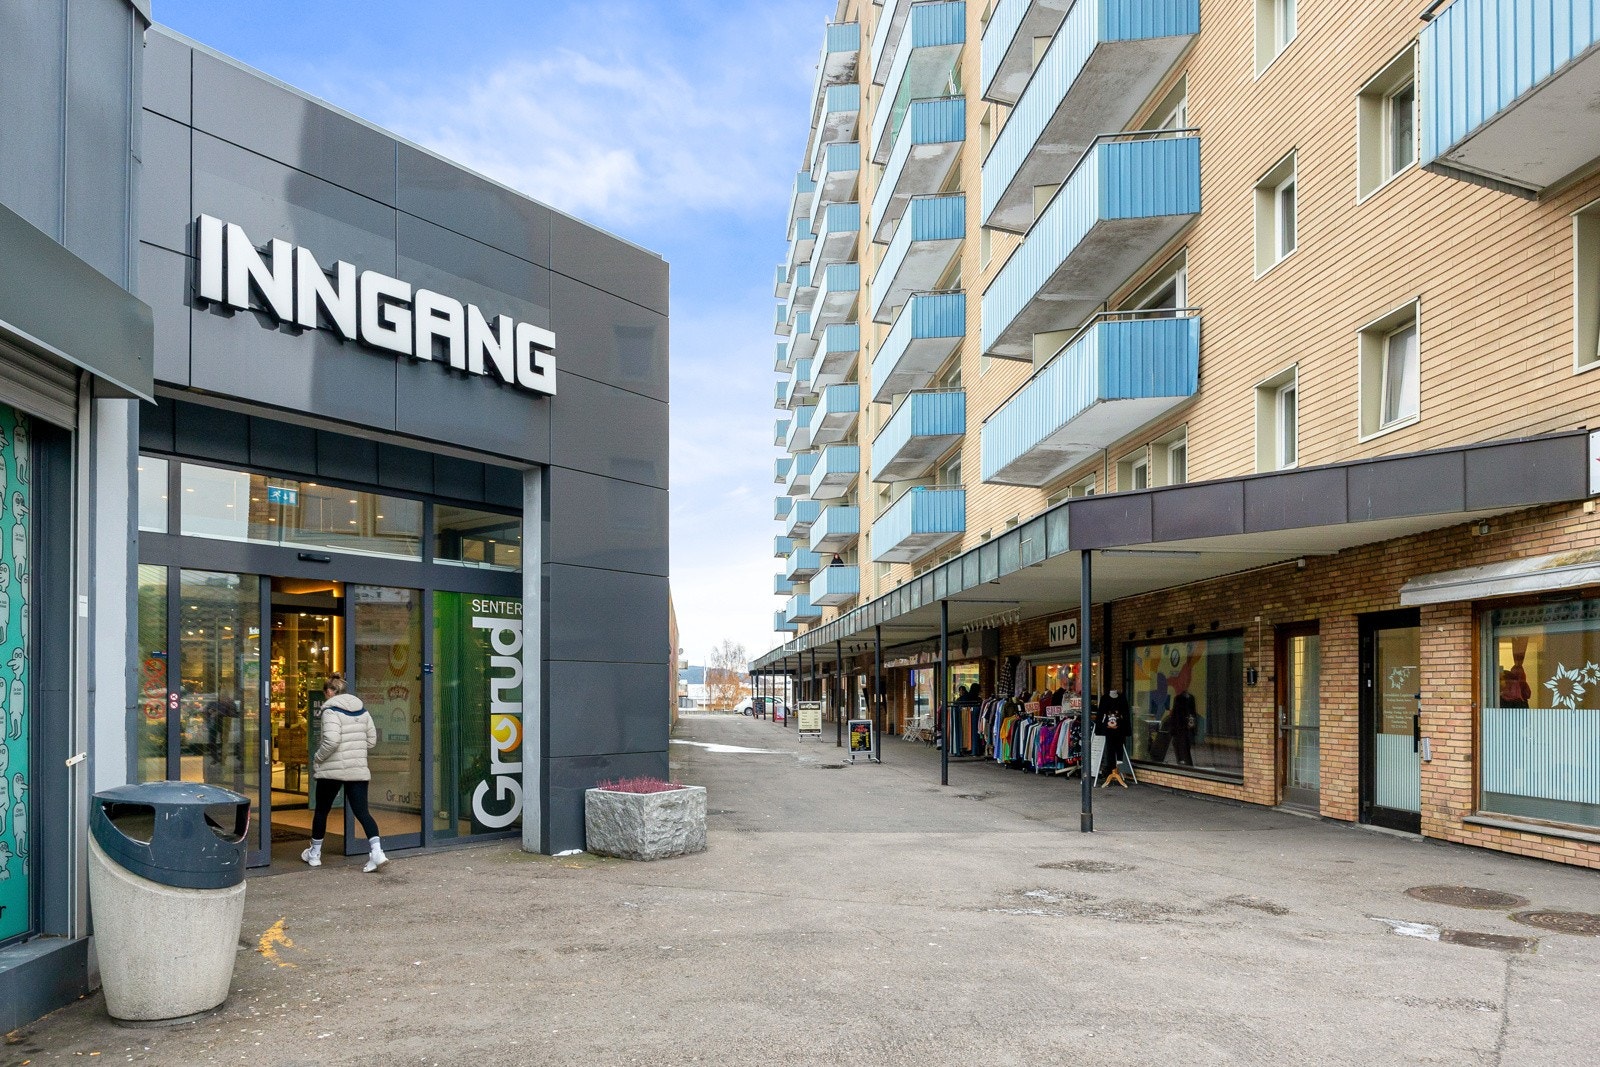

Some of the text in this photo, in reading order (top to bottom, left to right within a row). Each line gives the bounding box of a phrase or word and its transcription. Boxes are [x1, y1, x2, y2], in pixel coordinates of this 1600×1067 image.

[198, 213, 557, 396] INNGANG
[471, 599, 523, 615] SENTER
[1050, 623, 1076, 642] NIPO
[472, 616, 523, 829] Grorud
